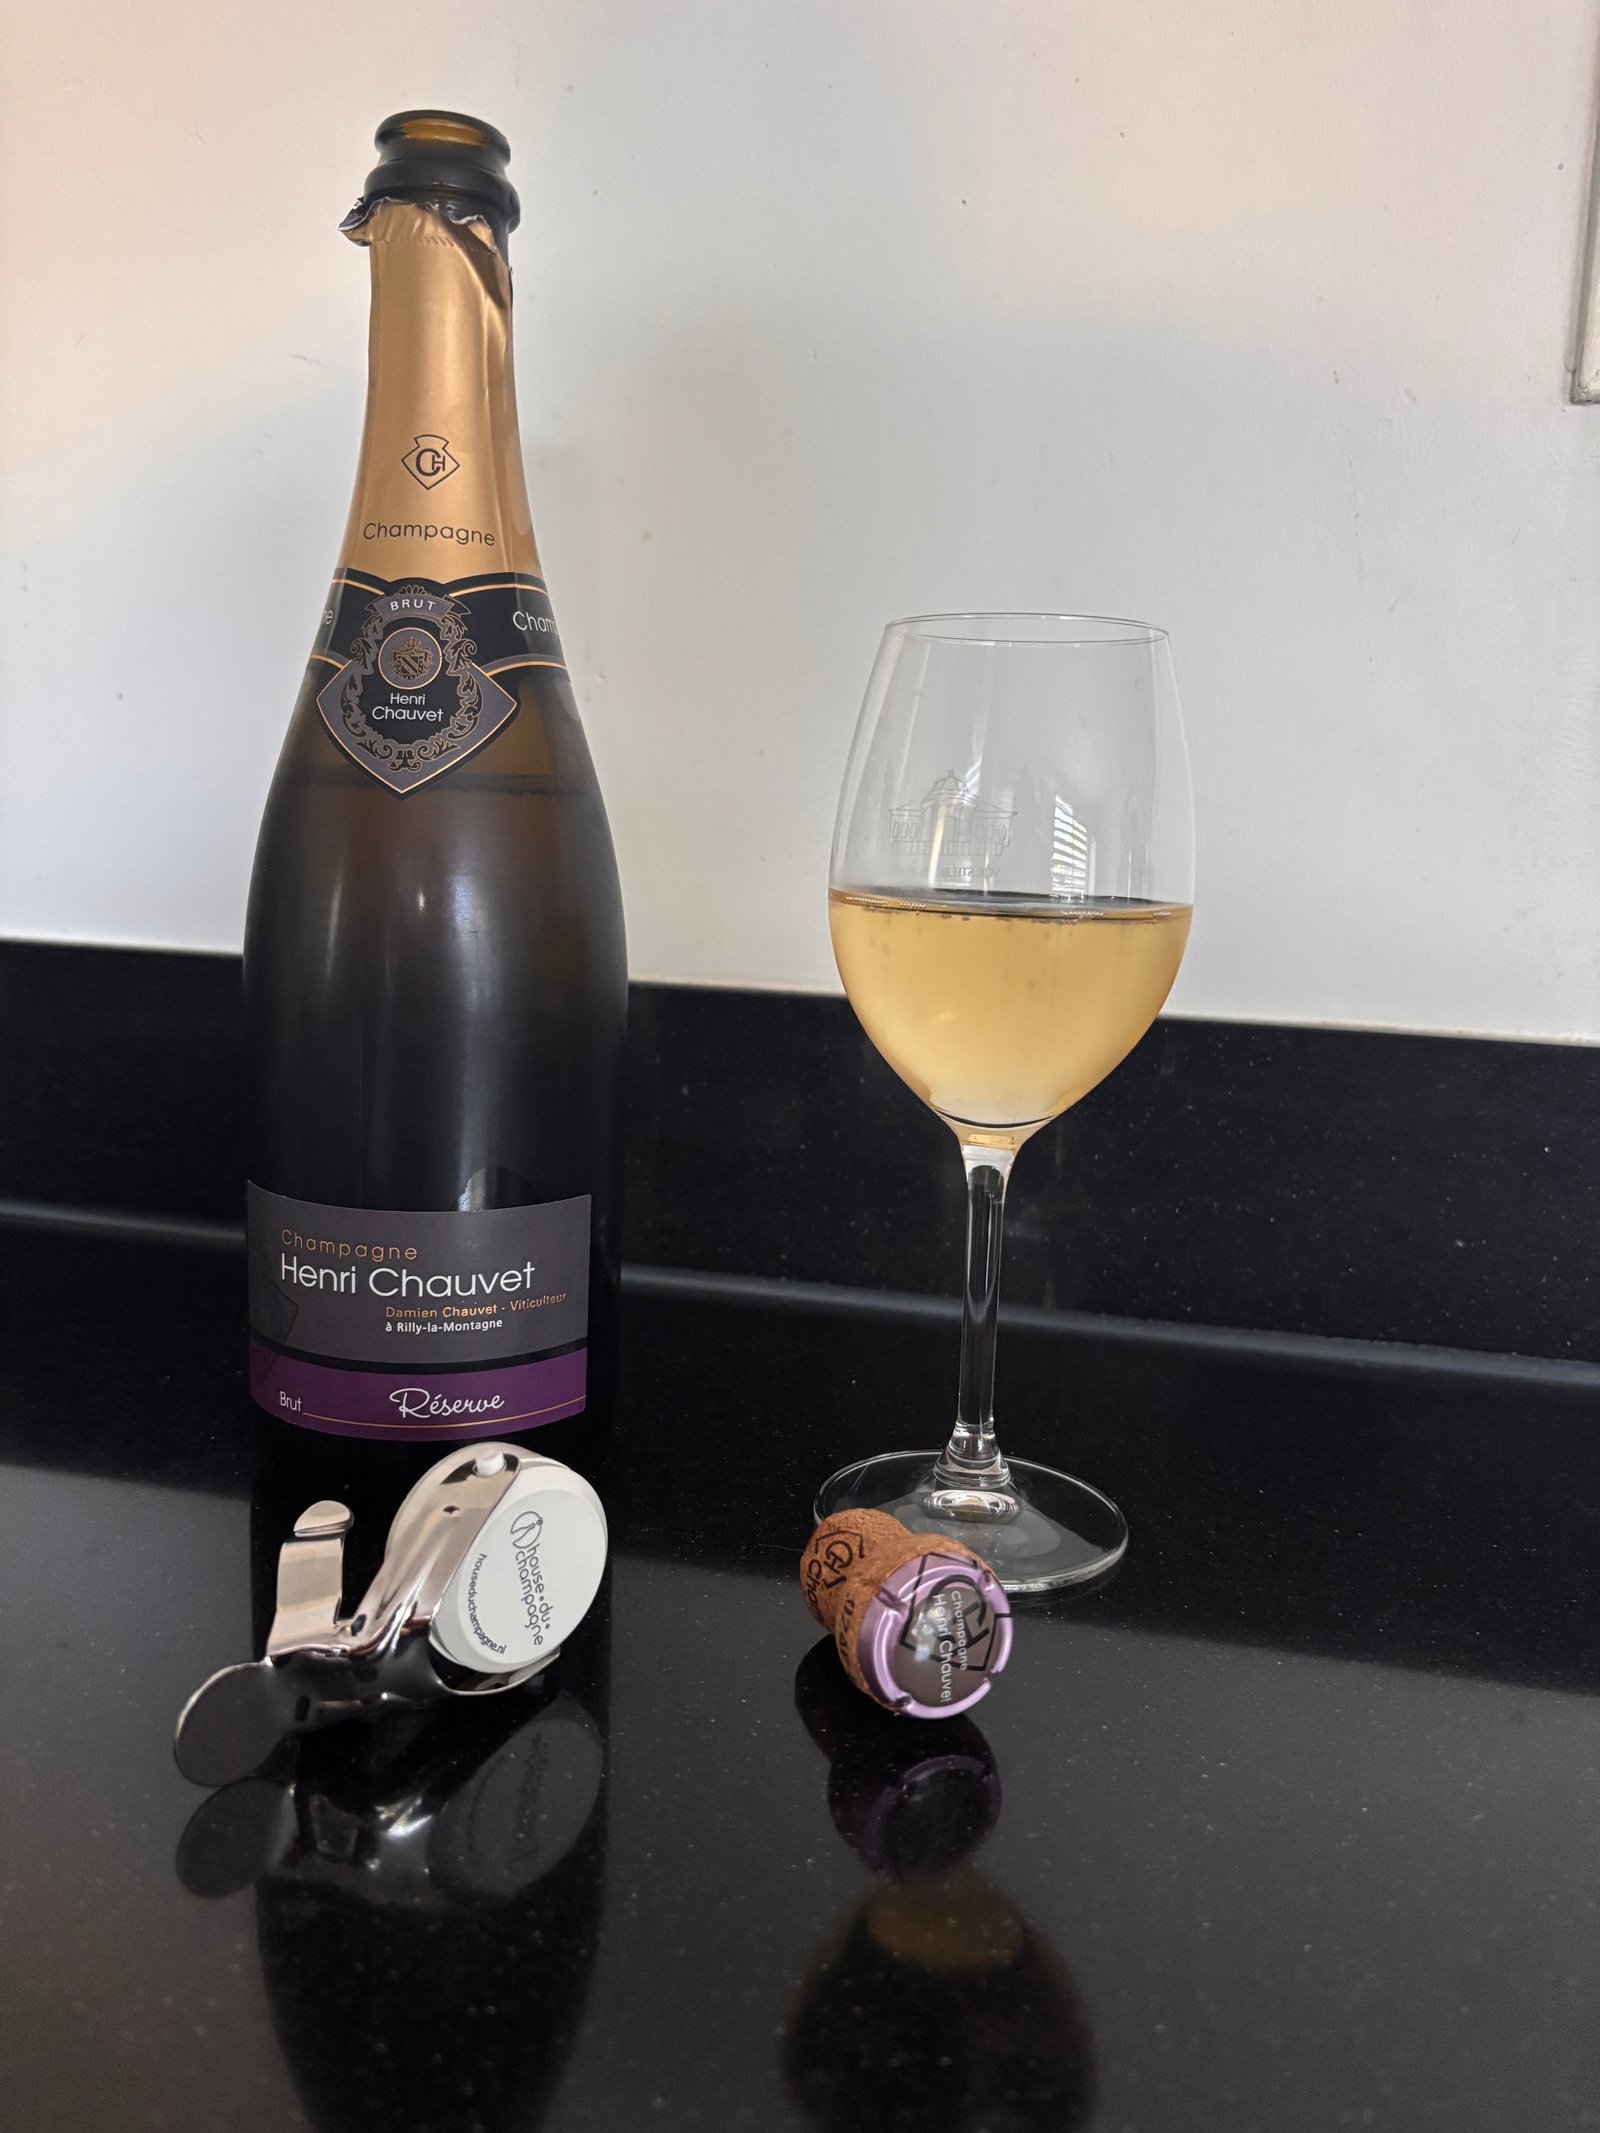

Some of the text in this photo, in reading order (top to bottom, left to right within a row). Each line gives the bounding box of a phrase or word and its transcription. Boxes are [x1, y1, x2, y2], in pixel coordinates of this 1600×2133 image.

[363, 521, 496, 547] Champagne
[390, 599, 437, 611] BRUT
[372, 706, 444, 722] Chauvet
[390, 692, 426, 706] Henri
[281, 1229, 418, 1262] Champagne
[281, 1252, 536, 1298] Henri Chauvet
[385, 1306, 438, 1318] Damien
[442, 1304, 498, 1318] Chauvet
[509, 1292, 567, 1312] Viticulteur
[385, 1319, 503, 1335] à Rilly-la-Montagne
[279, 1390, 302, 1413] Brut
[389, 1387, 505, 1418] Réserve
[515, 1550, 544, 1646] champagne
[526, 1543, 554, 1623] house du
[467, 1552, 508, 1655] houseduchampagne.nl
[932, 1593, 952, 1637] Henri
[951, 1590, 969, 1671] Champagne
